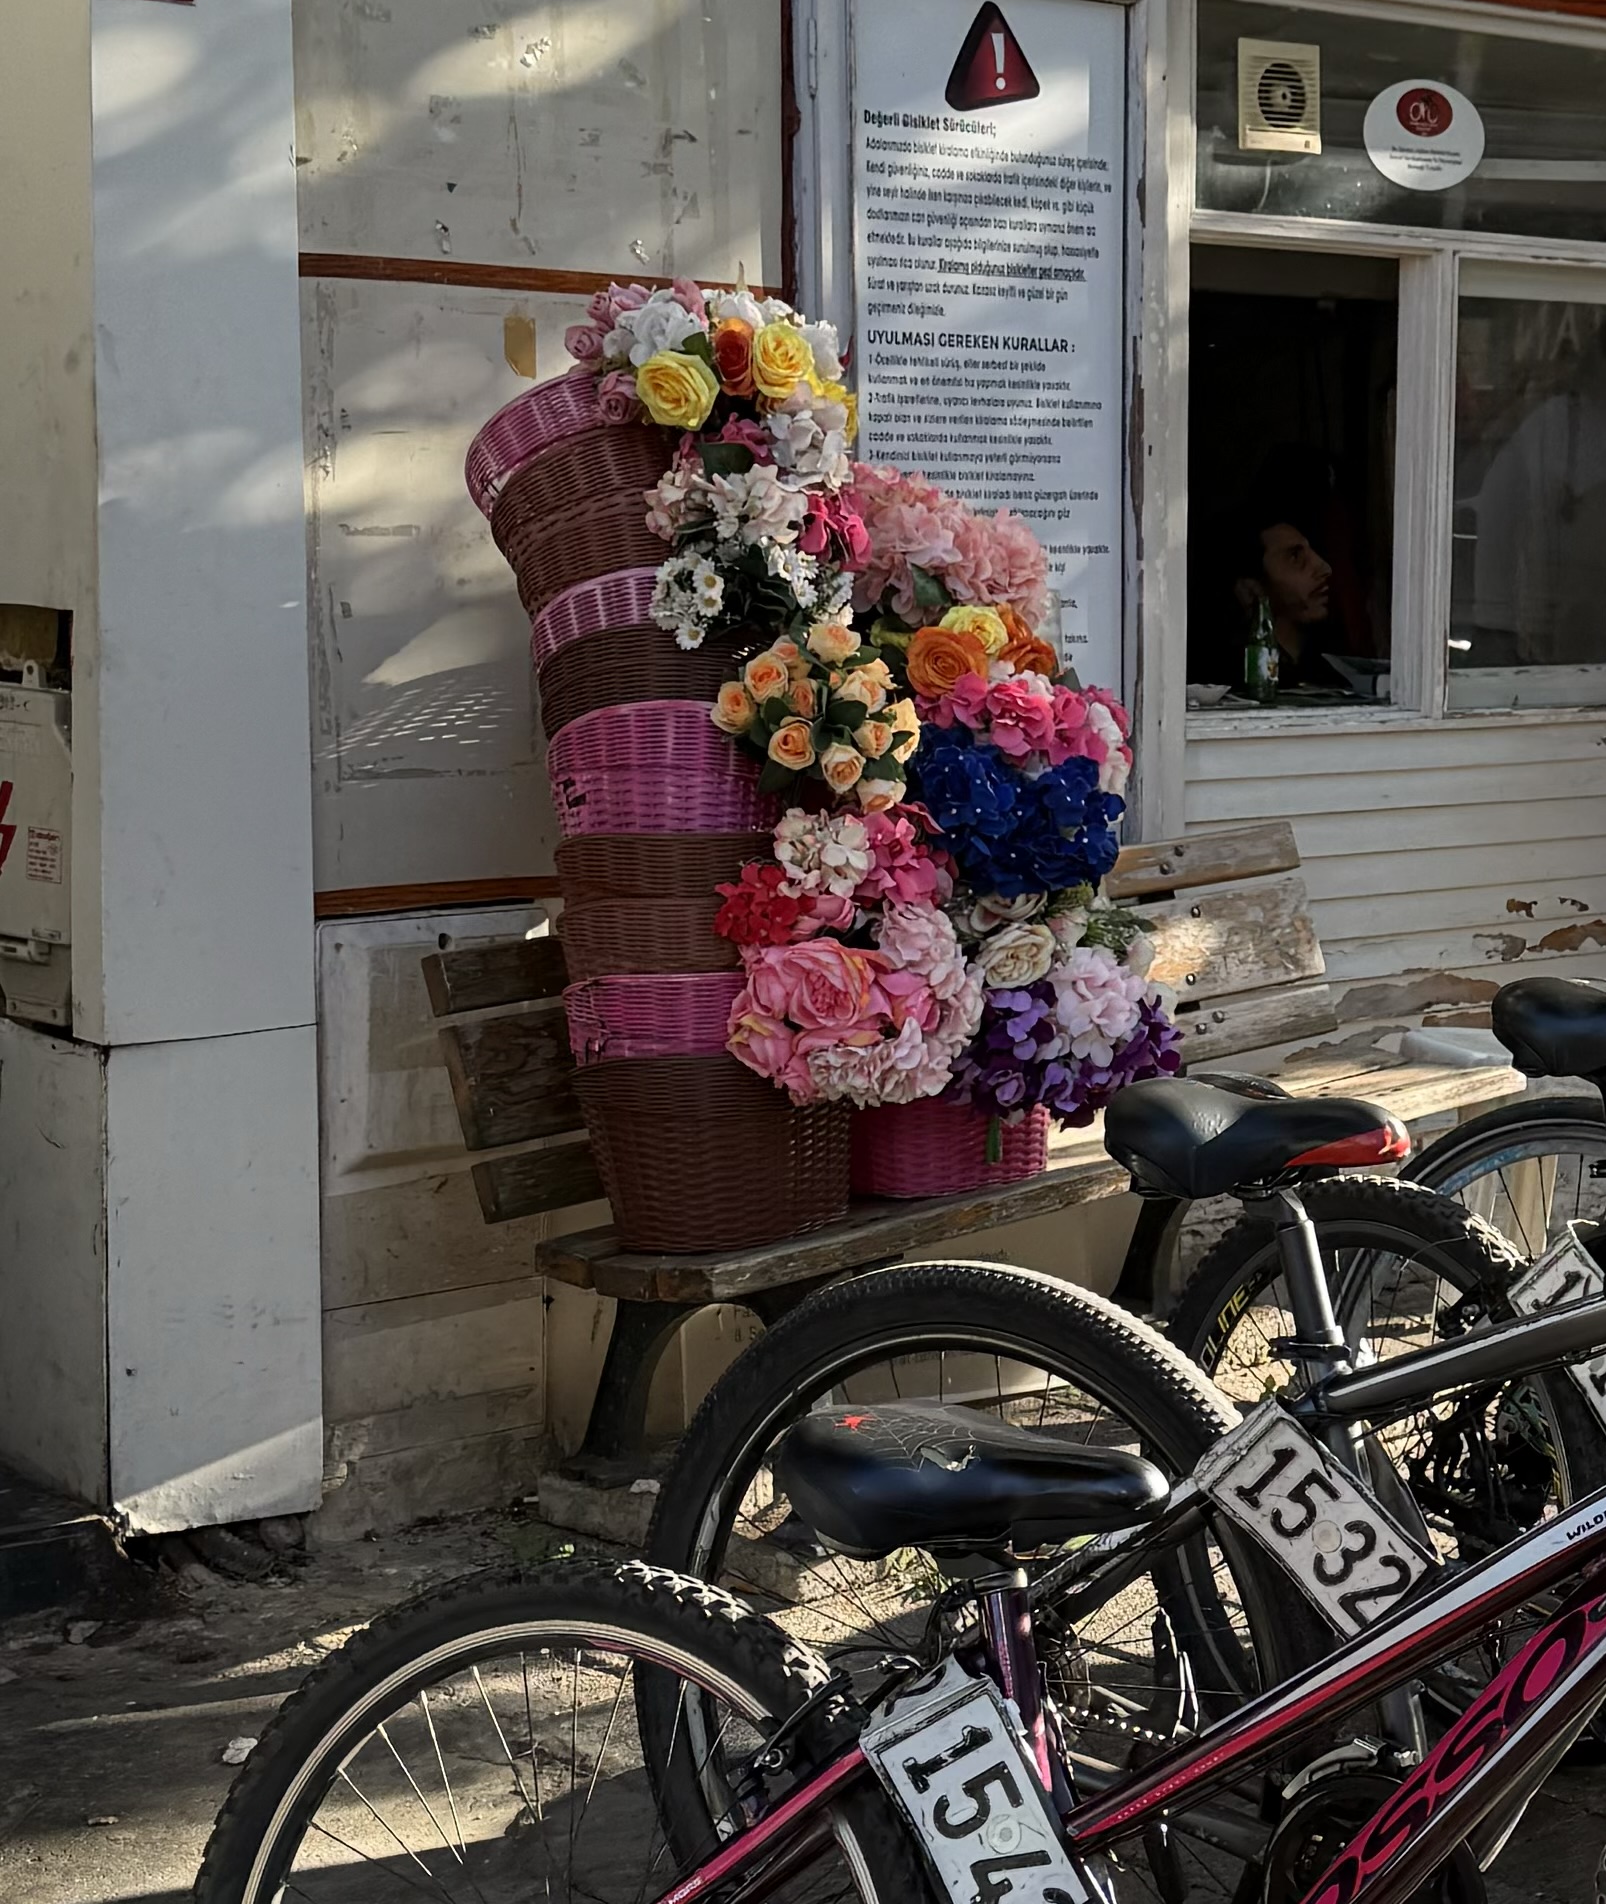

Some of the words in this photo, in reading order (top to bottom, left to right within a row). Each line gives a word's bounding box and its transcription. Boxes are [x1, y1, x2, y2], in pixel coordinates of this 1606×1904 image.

[864, 110, 900, 128] Değerli
[902, 113, 940, 131] Bisiklet
[868, 330, 934, 347] UYULMASI
[939, 333, 998, 350] GEREKEN
[1003, 335, 1068, 353] KURALLAR
[1234, 1447, 1412, 1629] 1532
